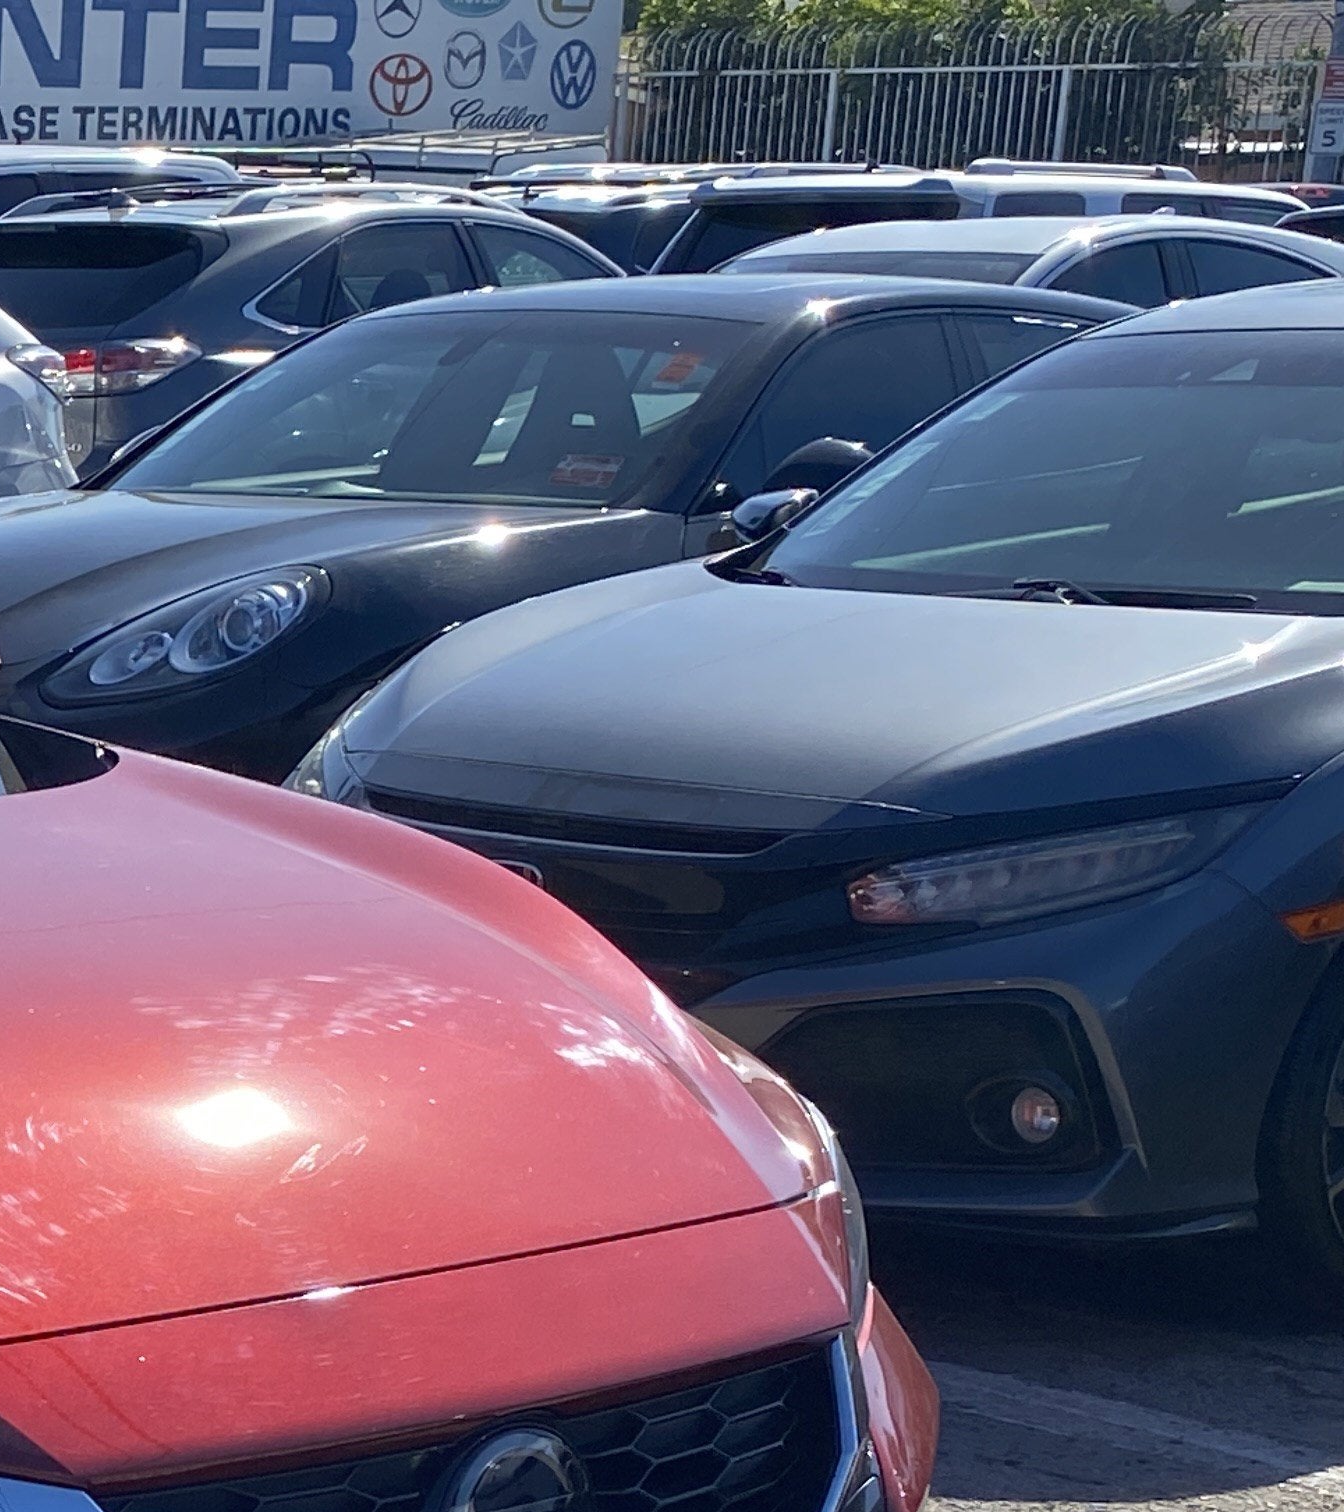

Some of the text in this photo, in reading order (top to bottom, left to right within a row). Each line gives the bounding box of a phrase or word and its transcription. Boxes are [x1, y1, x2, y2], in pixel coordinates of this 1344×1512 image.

[72, 105, 352, 142] TERMINATIONS
[449, 98, 549, 130] Cadillac
[1321, 130, 1337, 148] 5
